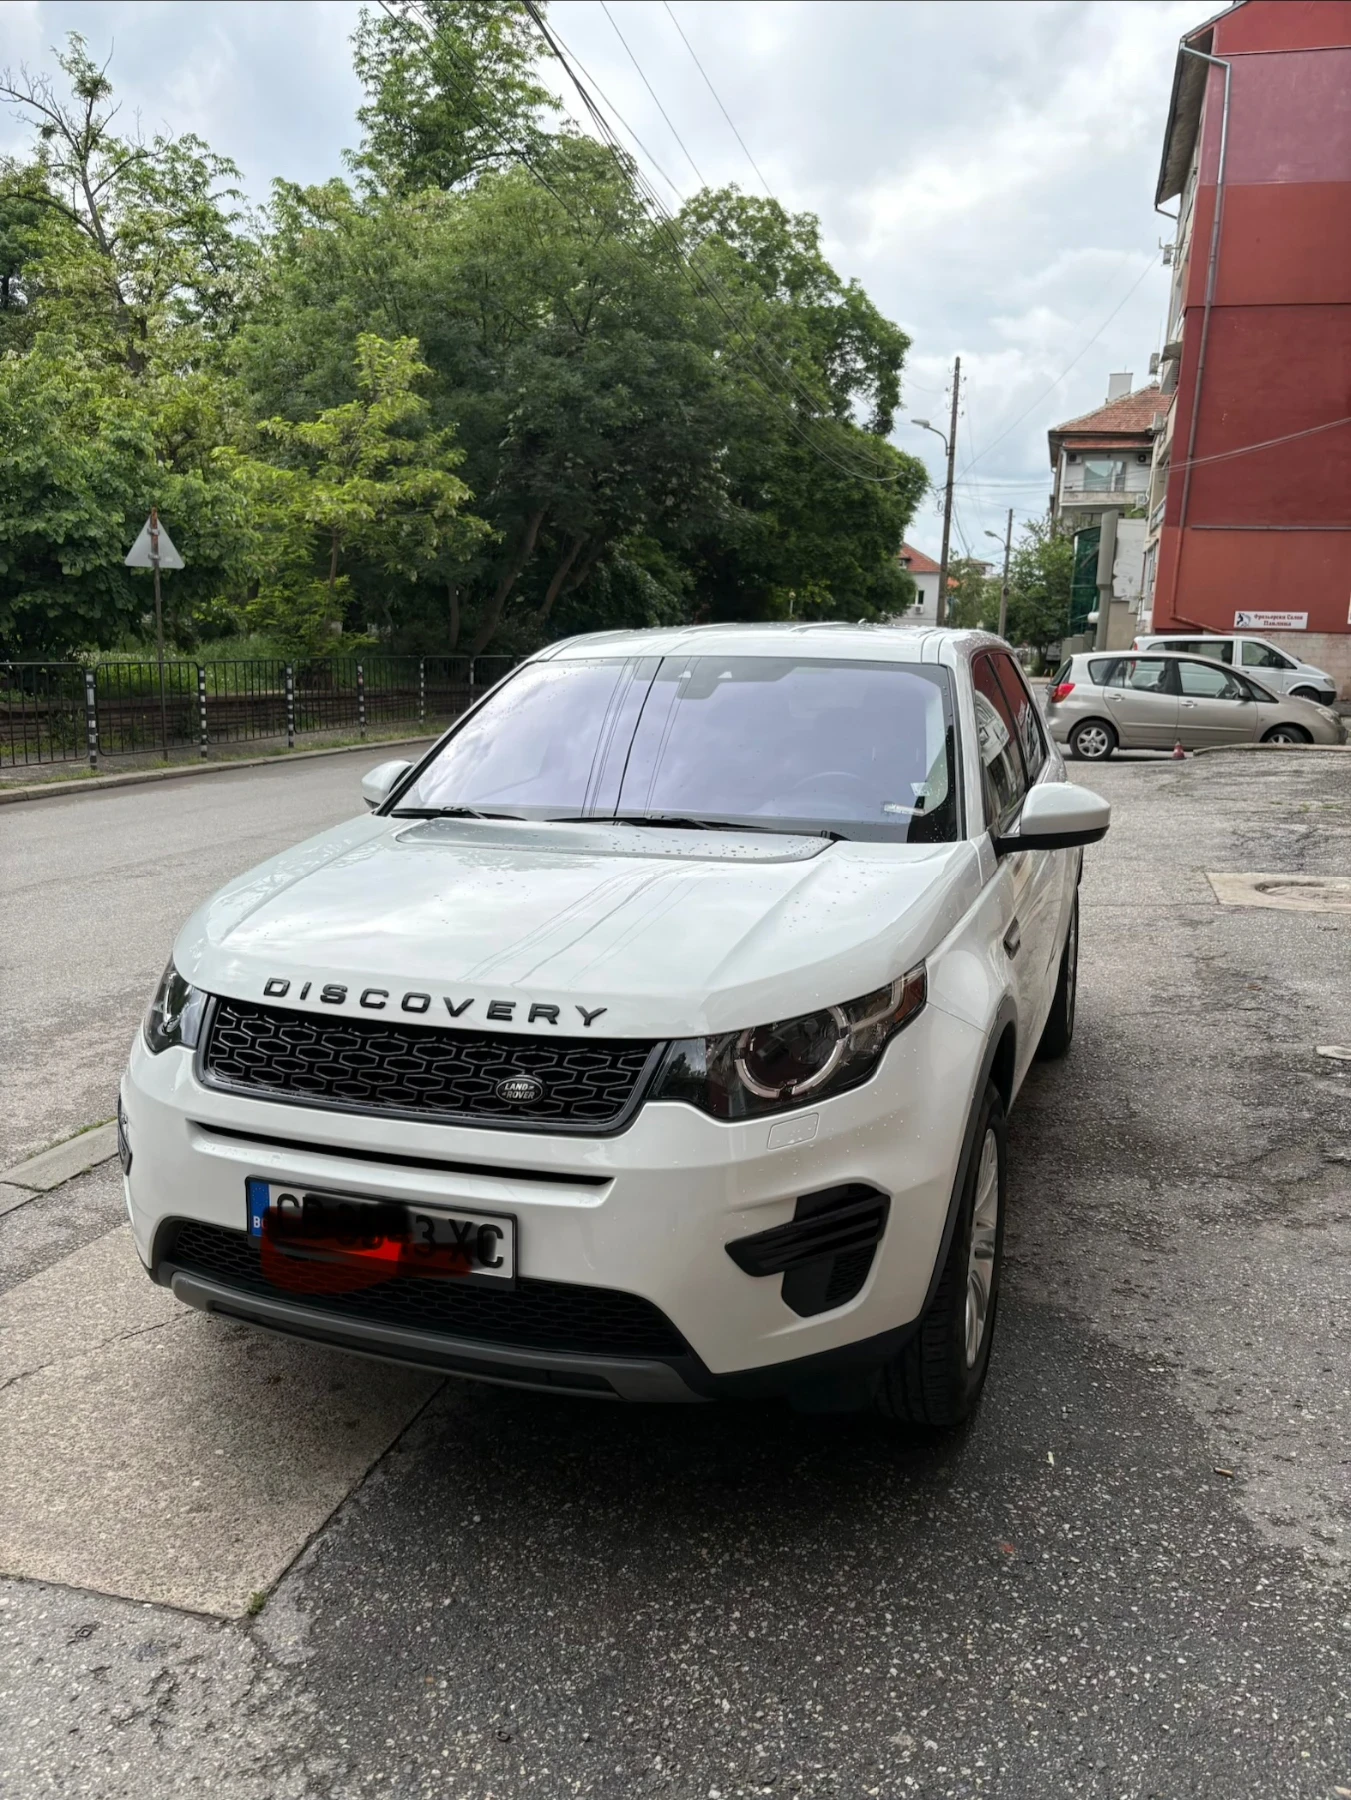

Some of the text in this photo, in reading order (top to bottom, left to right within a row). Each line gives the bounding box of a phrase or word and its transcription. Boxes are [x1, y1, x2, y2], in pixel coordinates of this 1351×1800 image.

[263, 977, 607, 1027] DISCOVERY
[504, 1083, 529, 1091] LAND
[506, 1091, 535, 1099] ROVER
